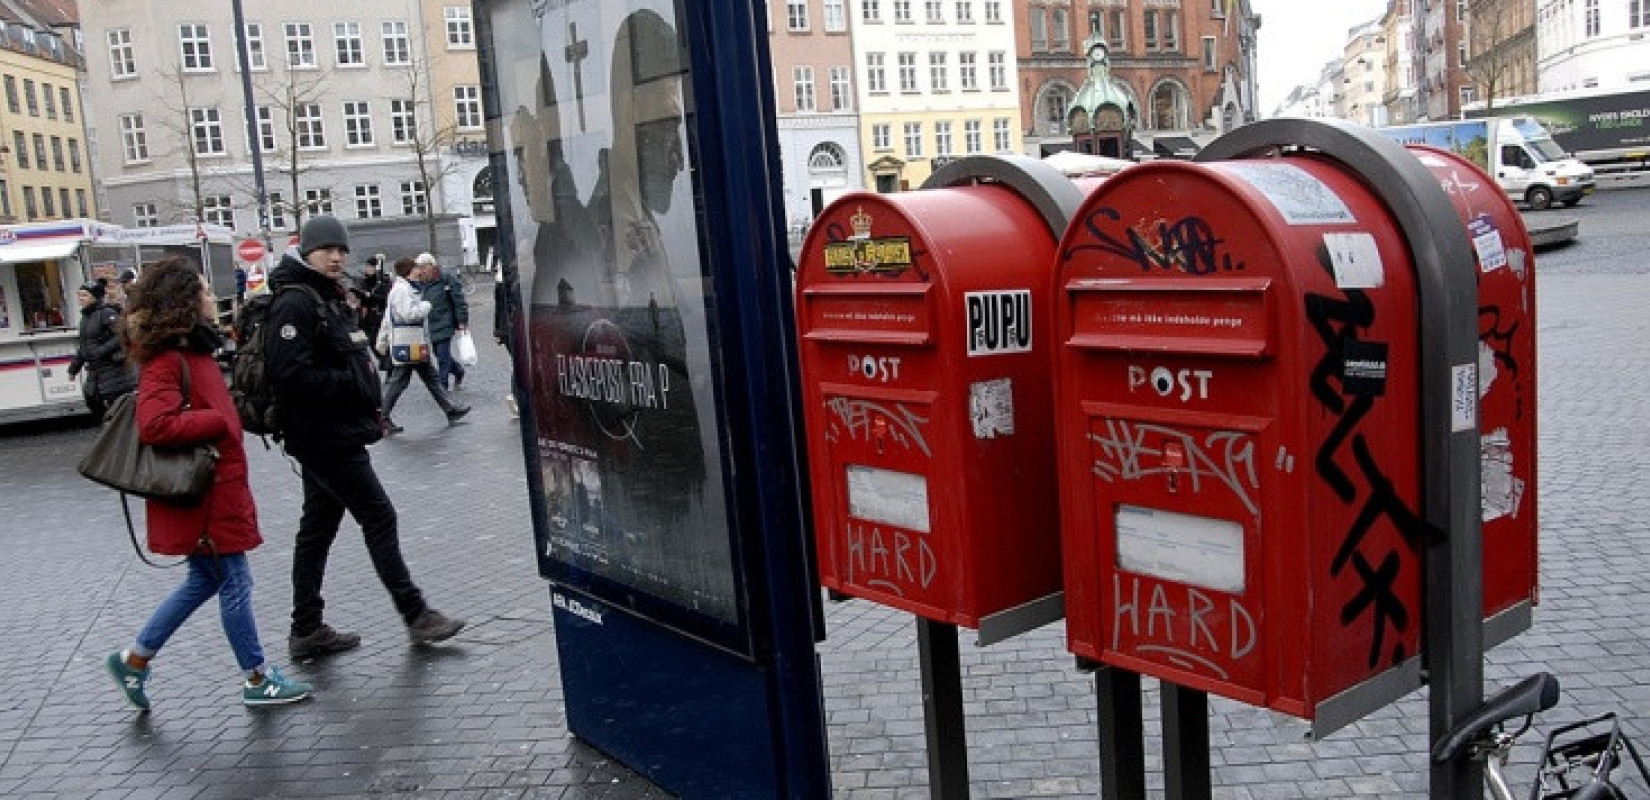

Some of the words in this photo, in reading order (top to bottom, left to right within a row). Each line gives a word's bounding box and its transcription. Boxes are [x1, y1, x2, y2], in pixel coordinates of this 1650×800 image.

[967, 293, 1029, 351] PUPU
[1213, 318, 1242, 328] penge
[847, 355, 900, 382] POST
[1128, 365, 1213, 402] POST
[847, 523, 937, 589] HARD
[1112, 574, 1257, 660] HARD
